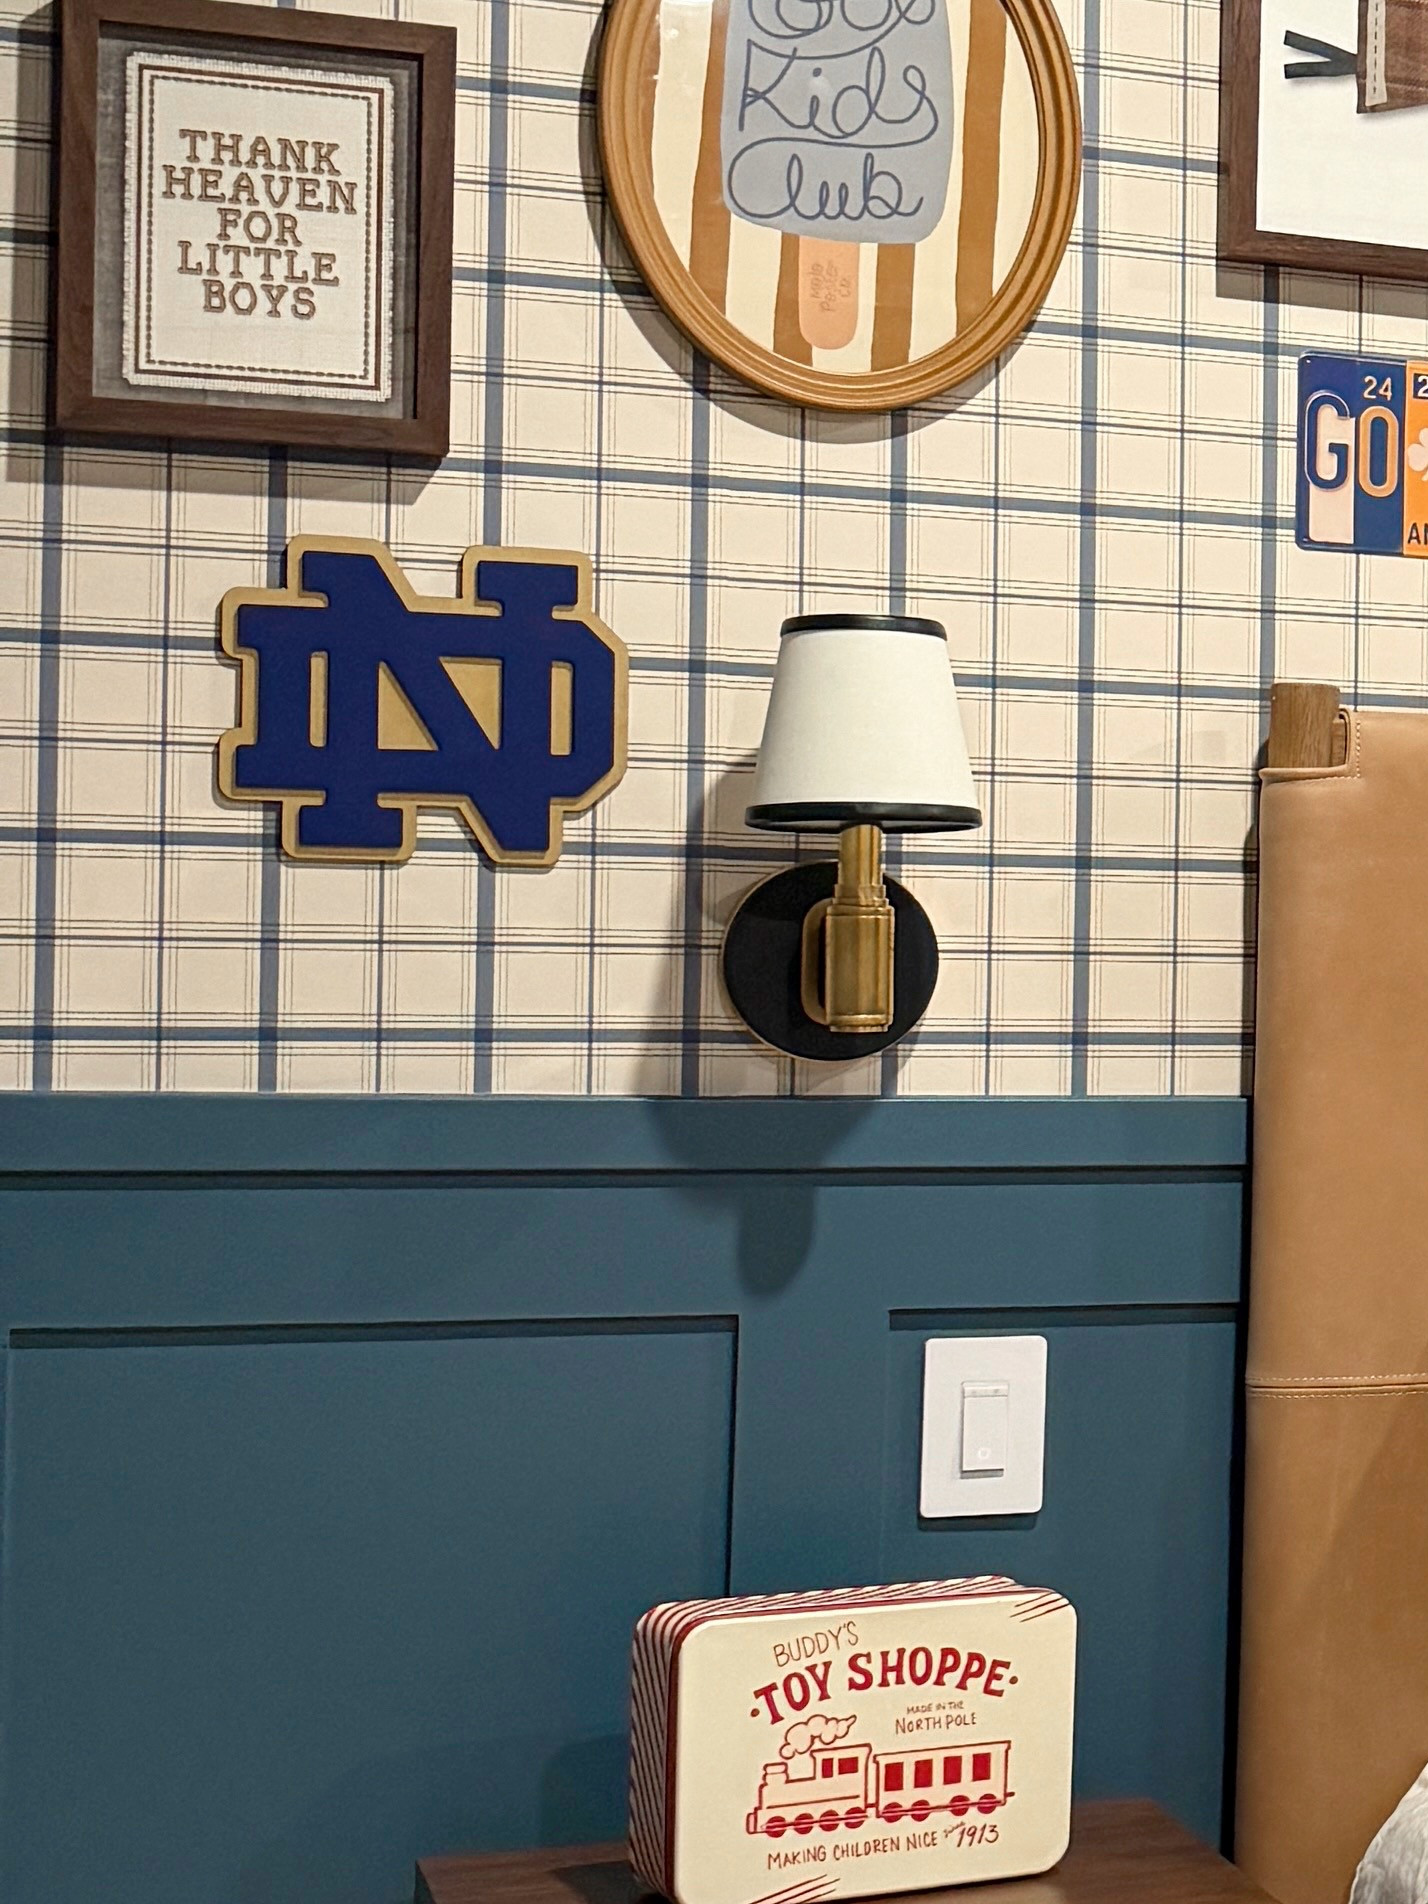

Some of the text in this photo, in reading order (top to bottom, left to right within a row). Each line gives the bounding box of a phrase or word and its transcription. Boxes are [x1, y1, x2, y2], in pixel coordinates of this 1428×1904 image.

[737, 38, 939, 142] Kids
[178, 128, 342, 177] THANK
[161, 164, 358, 215] HEAVEN
[727, 136, 924, 221] Club
[216, 207, 303, 247] FOR
[177, 240, 340, 287] LITTLE
[202, 278, 317, 320] BOYS
[1362, 375, 1393, 401] 24
[1304, 389, 1399, 498] GO
[773, 1620, 859, 1668] BUDDY'S
[753, 1647, 1012, 1726] TOY SHOPPE
[906, 1702, 933, 1715] MADE
[895, 1712, 977, 1735] NORTH POLE
[767, 1845, 827, 1870] MAKING
[832, 1837, 901, 1861] CHILDREN
[905, 1831, 938, 1852] NICE
[956, 1823, 999, 1847] 1913
